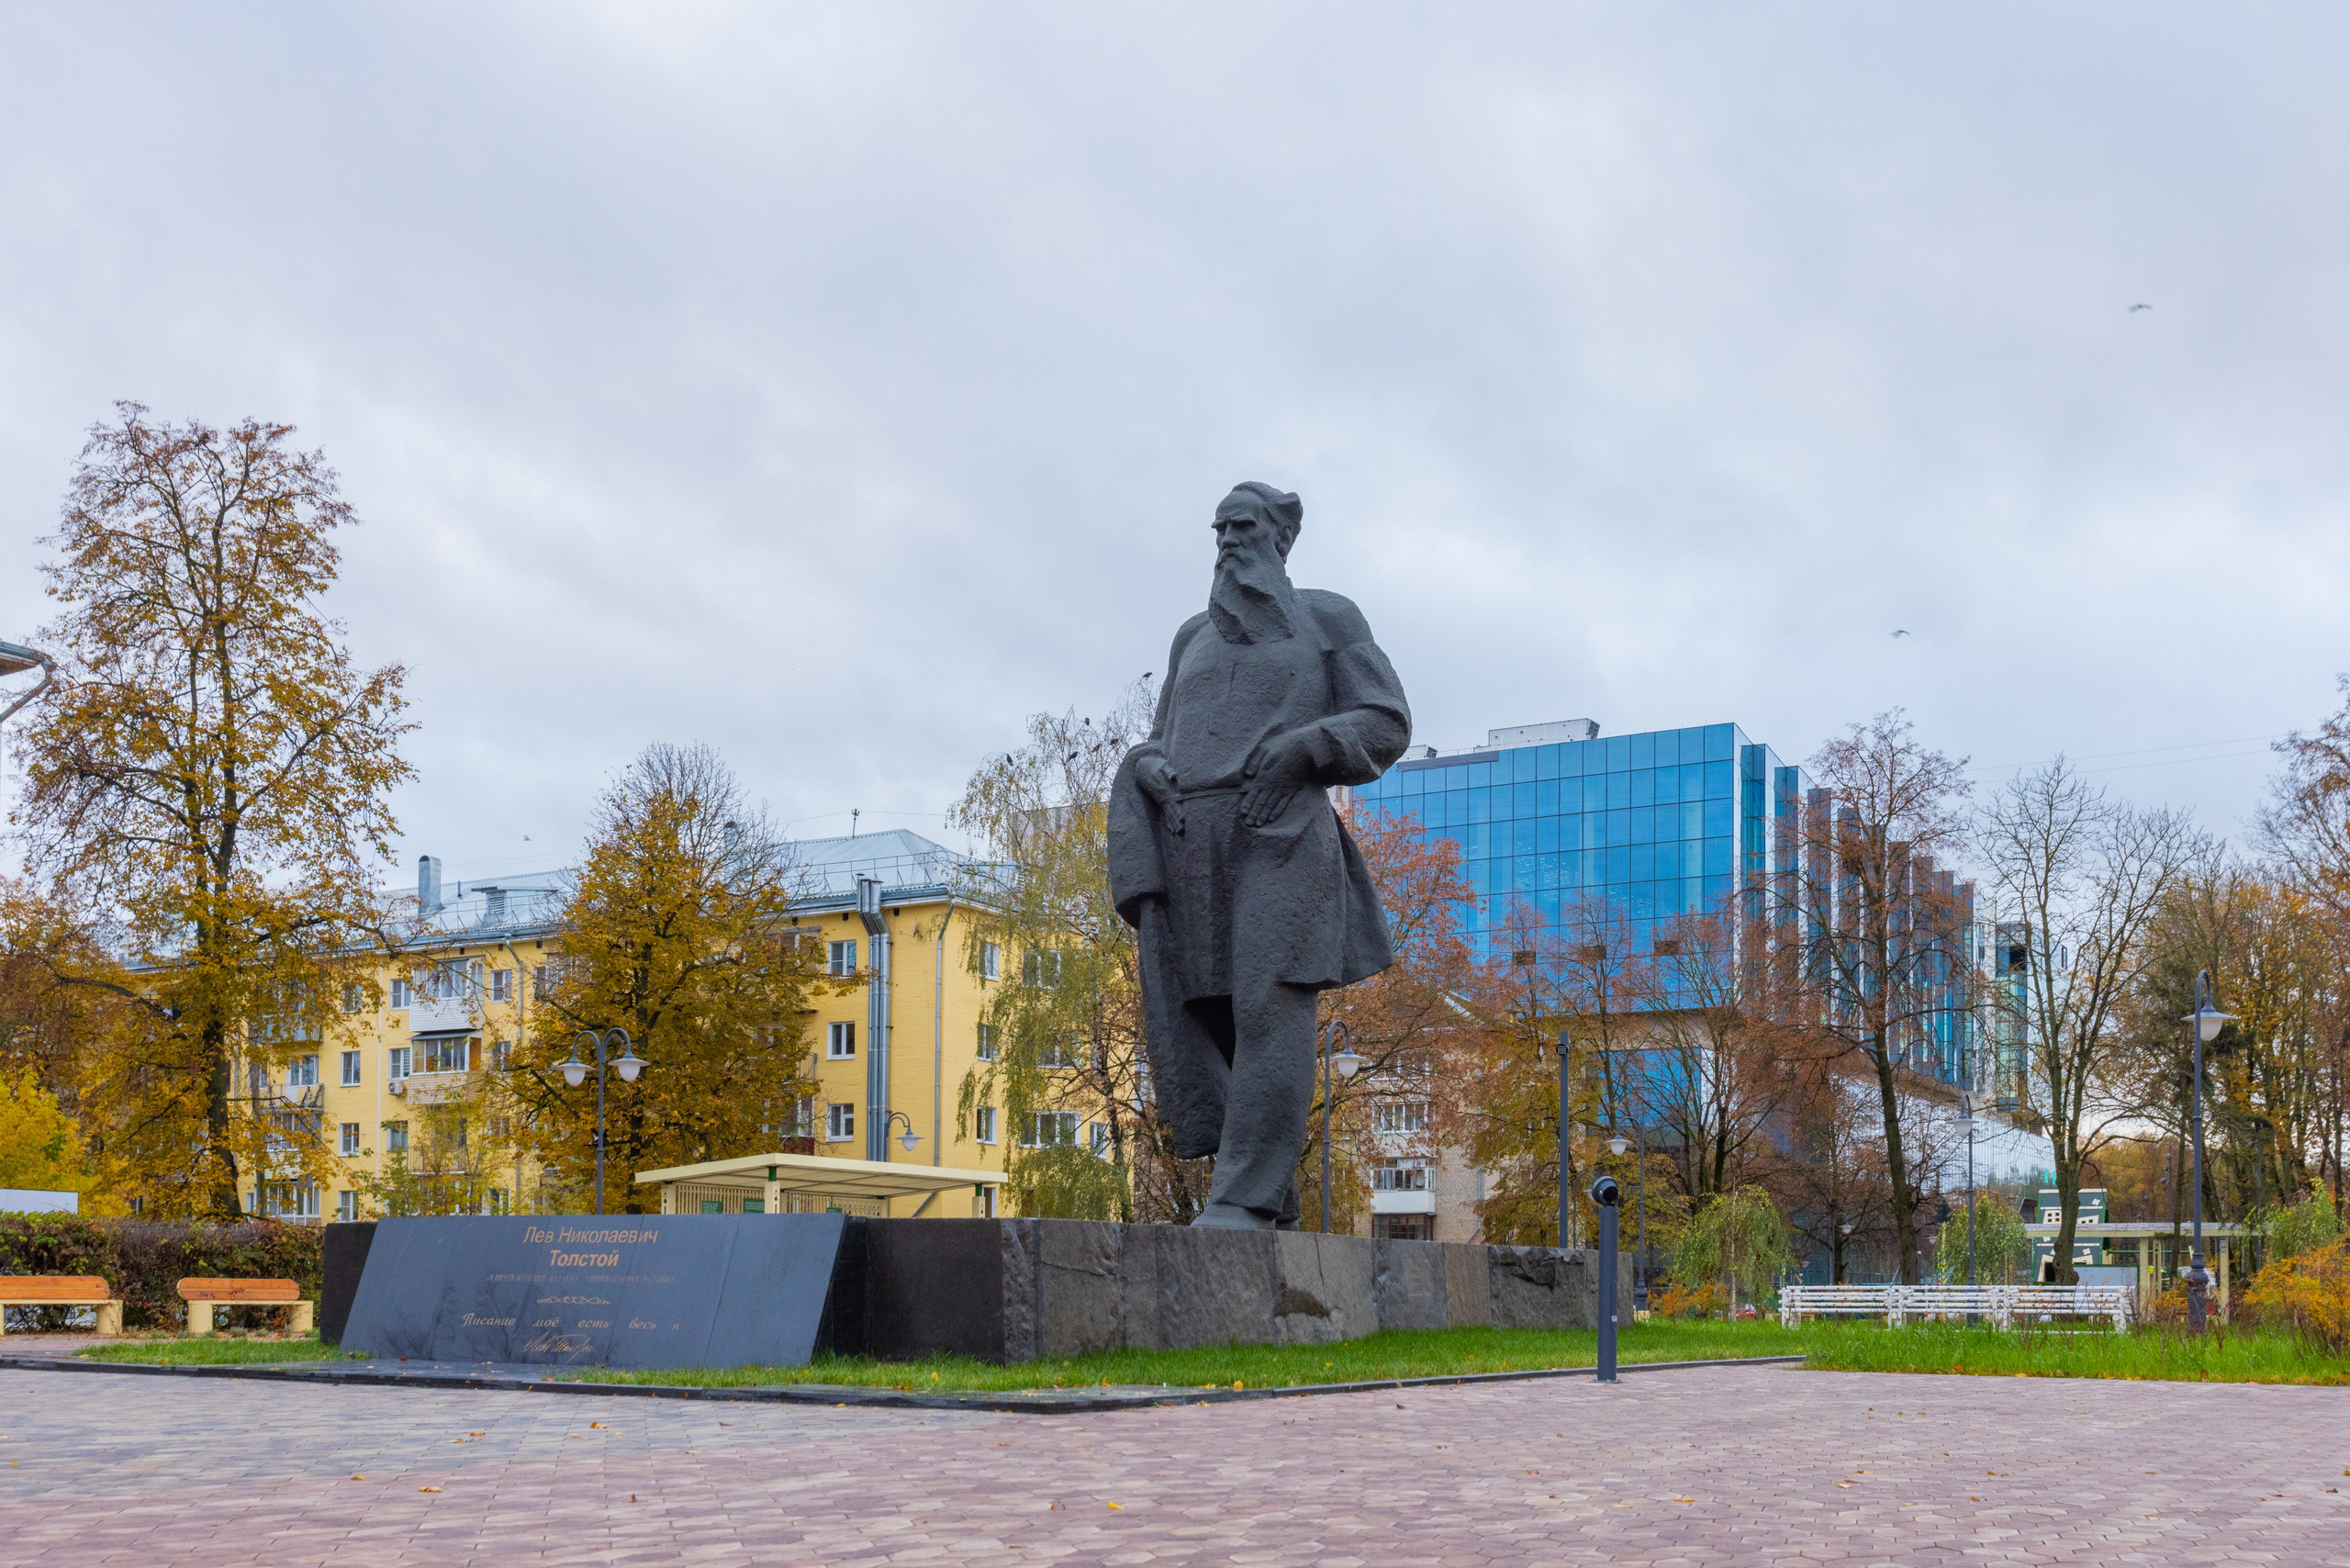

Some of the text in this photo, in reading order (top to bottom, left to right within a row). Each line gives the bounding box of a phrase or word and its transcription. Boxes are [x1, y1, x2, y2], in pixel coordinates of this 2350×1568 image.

[522, 1226, 658, 1244] Лев Николаевич
[550, 1249, 620, 1267] Толстой
[462, 1313, 516, 1327] Писание
[532, 1317, 560, 1327] моё
[577, 1319, 610, 1328] есть
[629, 1316, 656, 1329] весь
